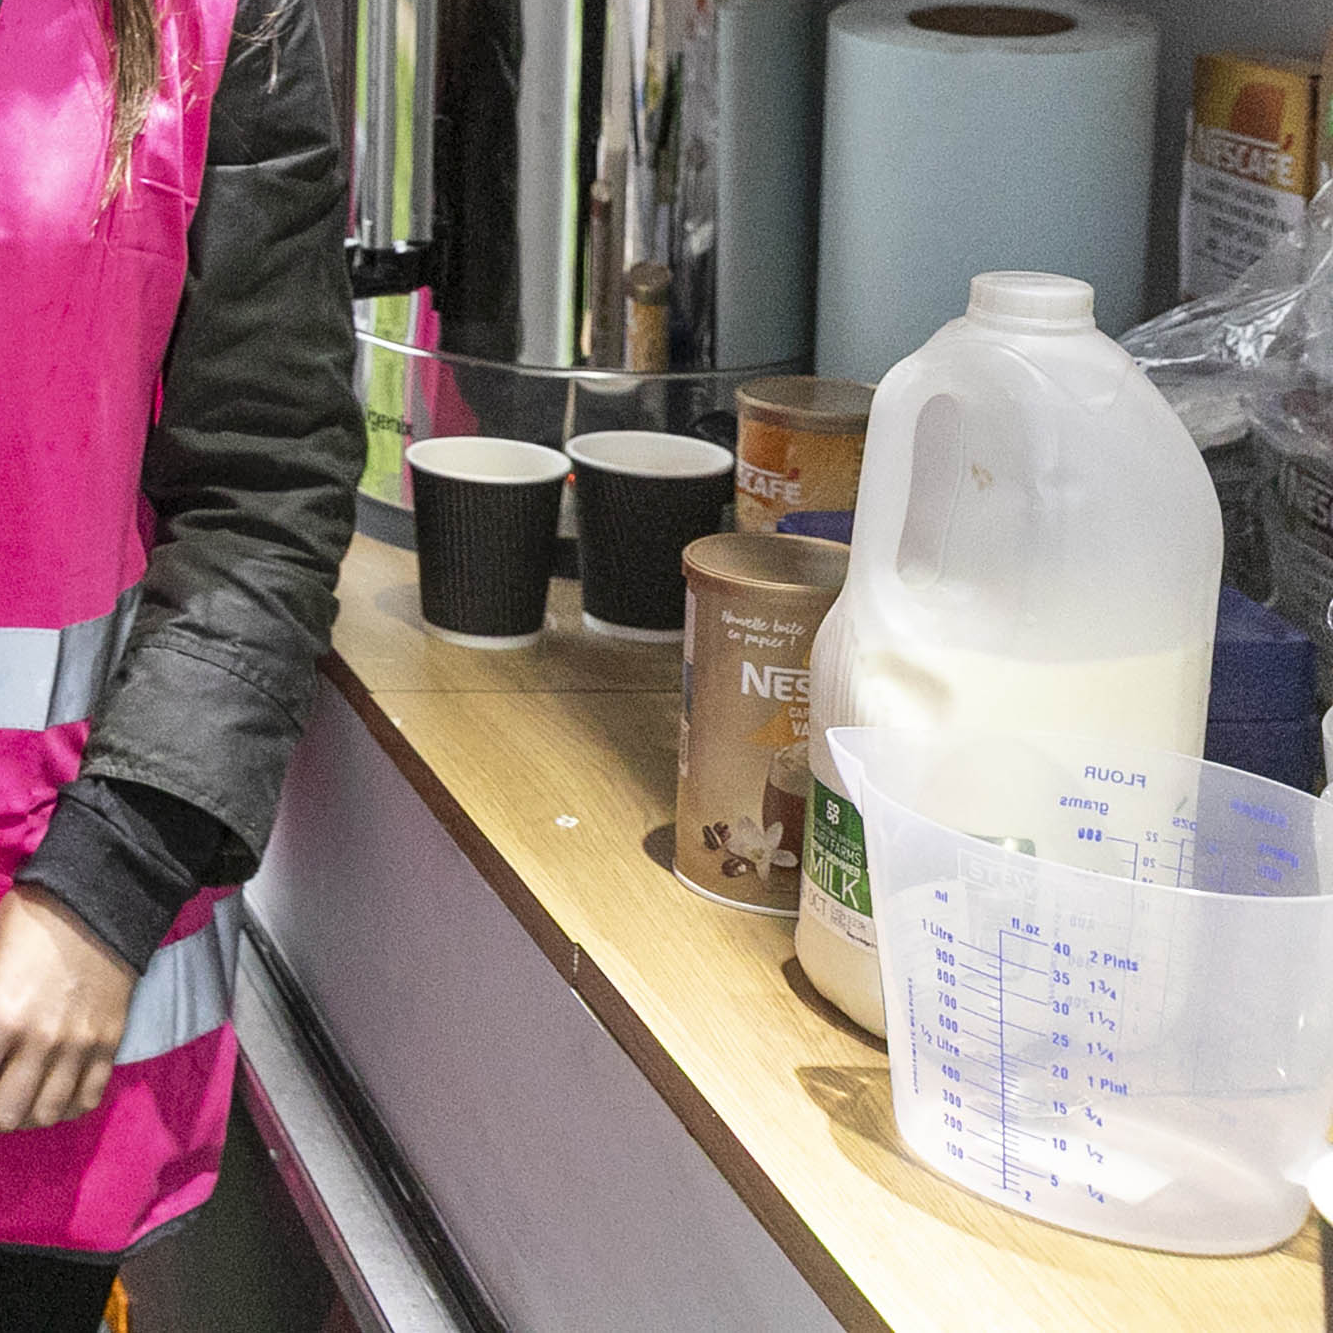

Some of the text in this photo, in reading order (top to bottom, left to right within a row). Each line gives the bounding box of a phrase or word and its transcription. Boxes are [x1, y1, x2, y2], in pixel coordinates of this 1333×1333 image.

[809, 848, 860, 910] MILK
[922, 918, 954, 943] 1 Litre
[935, 947, 955, 967] 900
[1053, 941, 1071, 957] 40
[1090, 950, 1098, 964] 2
[1103, 954, 1139, 972] Pints
[936, 968, 956, 987] 800
[1052, 969, 1070, 985] 35
[937, 990, 957, 1010] 700
[1052, 1000, 1070, 1017] 30
[938, 1014, 958, 1034] 600
[936, 1035, 961, 1057] Litre
[1052, 1032, 1070, 1048] 25
[941, 1064, 961, 1083] 400
[1051, 1064, 1069, 1080] 20
[1087, 1075, 1129, 1096] 1 Pint
[942, 1089, 962, 1109] 300
[1053, 1101, 1068, 1116] 15
[943, 1113, 963, 1132] 200
[946, 1141, 964, 1160] 100
[1052, 1137, 1067, 1152] 10
[1050, 1174, 1059, 1187] 5
